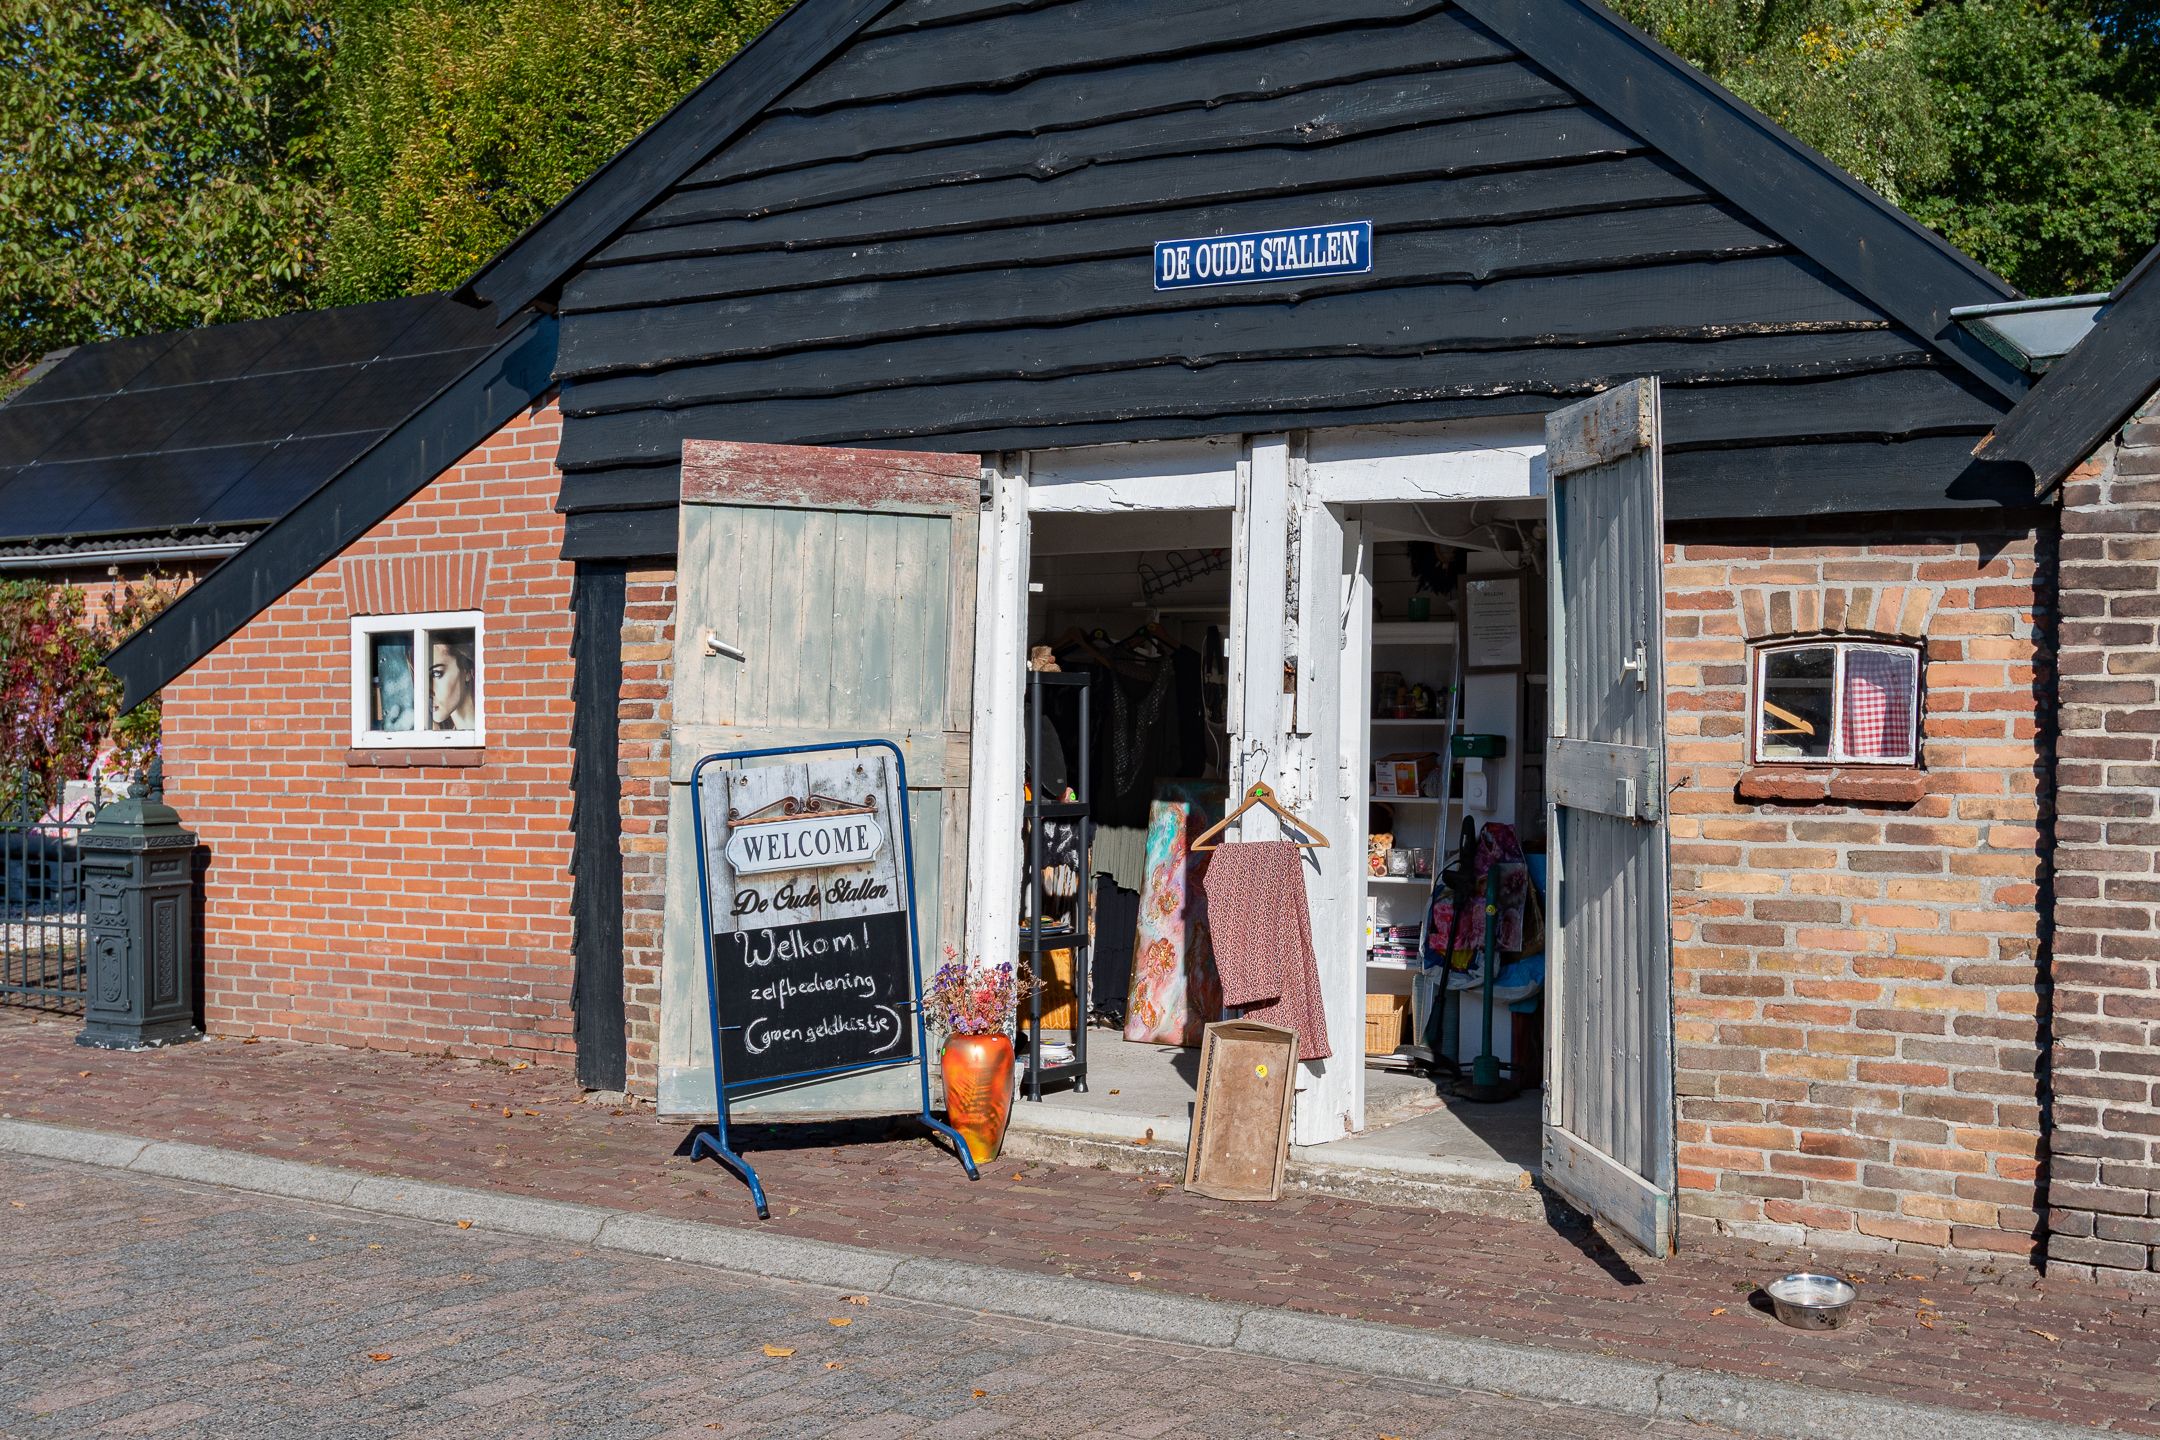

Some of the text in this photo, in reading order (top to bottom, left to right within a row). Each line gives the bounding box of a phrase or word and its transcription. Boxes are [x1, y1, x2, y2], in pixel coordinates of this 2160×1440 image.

[1162, 230, 1360, 281] DE OUDE STALLEN
[743, 824, 869, 863] WELCOME
[730, 877, 889, 916] De Oude Stallen
[750, 972, 876, 1009] zelfbediening
[744, 1016, 803, 1055] (groen
